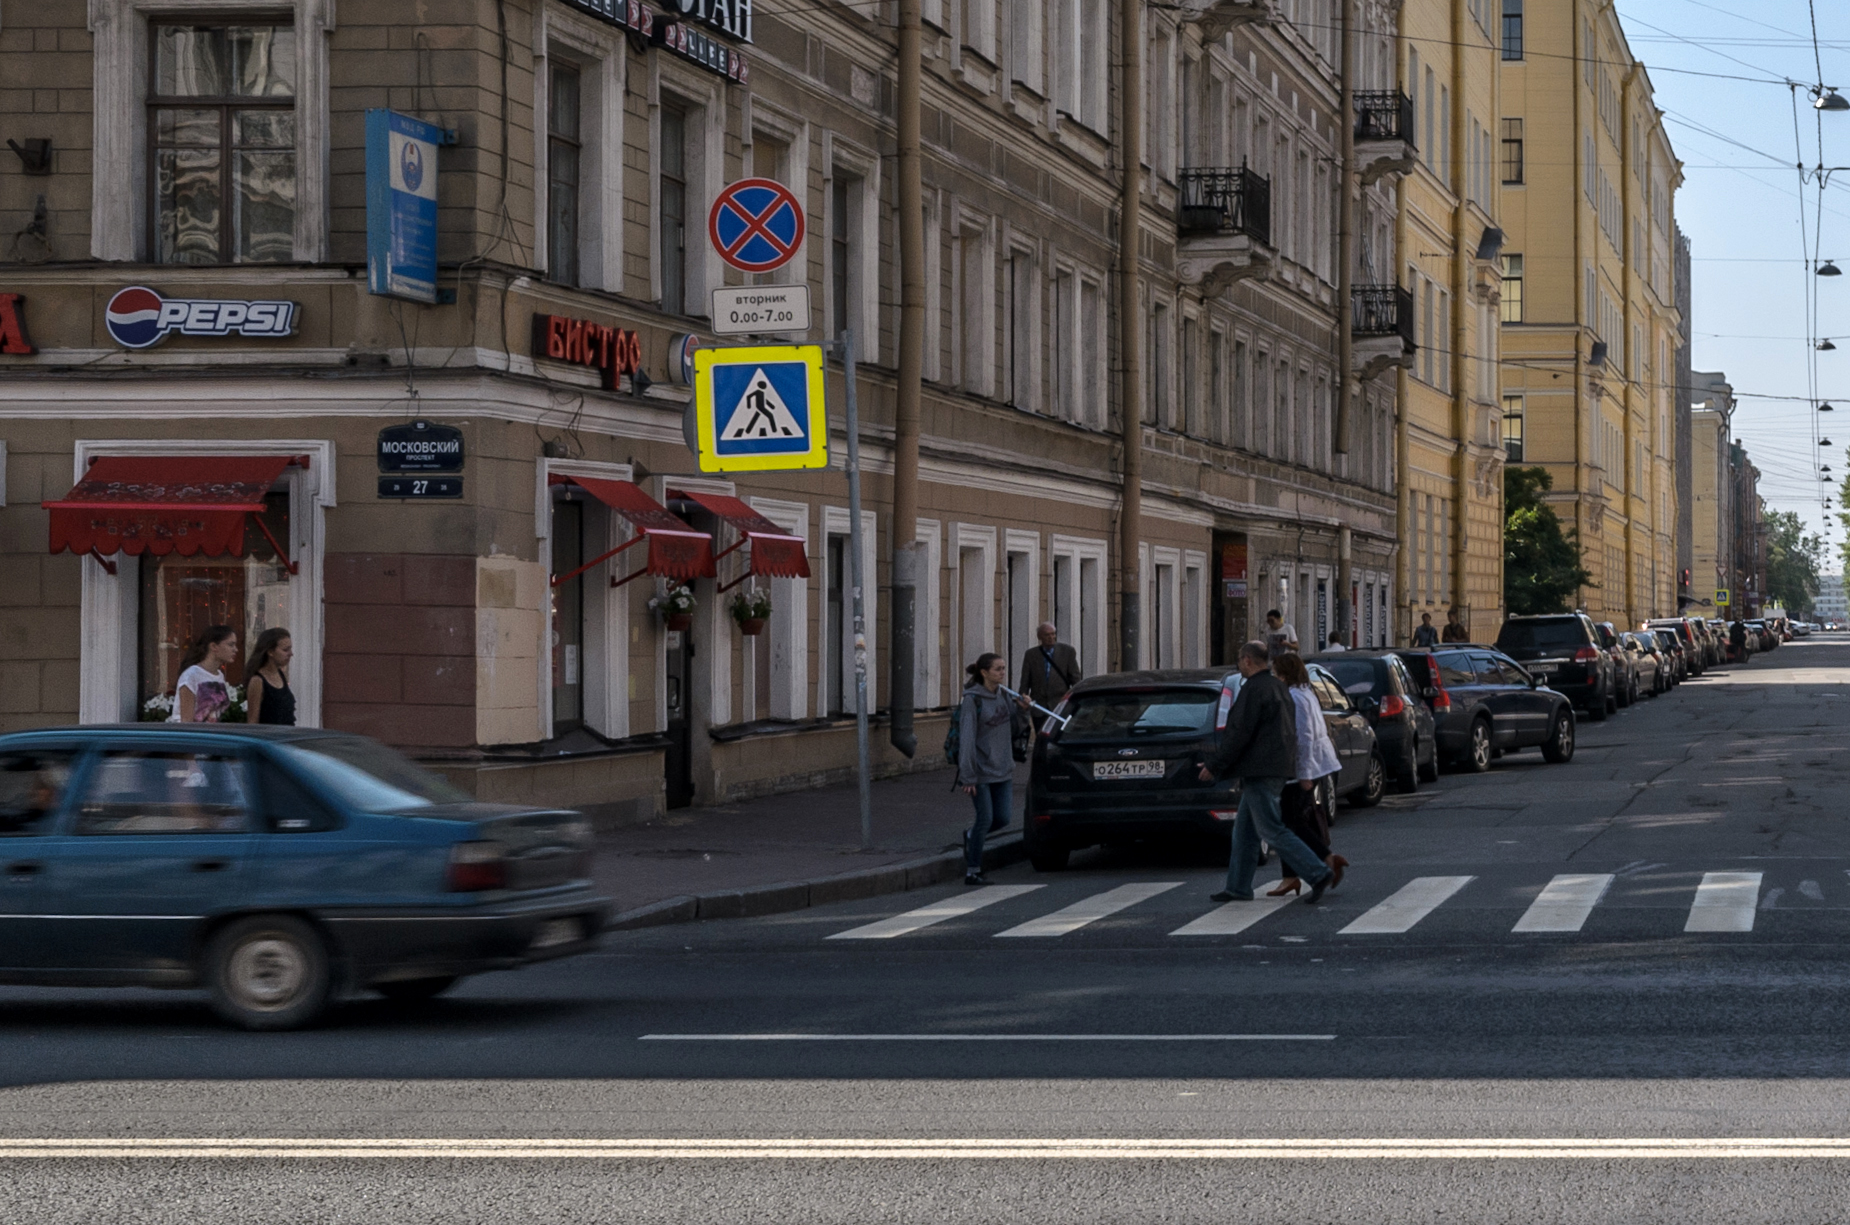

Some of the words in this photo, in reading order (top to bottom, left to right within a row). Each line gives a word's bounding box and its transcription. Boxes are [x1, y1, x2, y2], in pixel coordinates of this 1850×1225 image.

[736, 295, 787, 307] вторник
[156, 302, 289, 331] PEPSI
[730, 309, 793, 323] 0.00-7.00
[382, 439, 459, 453] МОСКОВСКИЙ
[413, 480, 429, 494] 27
[1318, 590, 1327, 642] интернет
